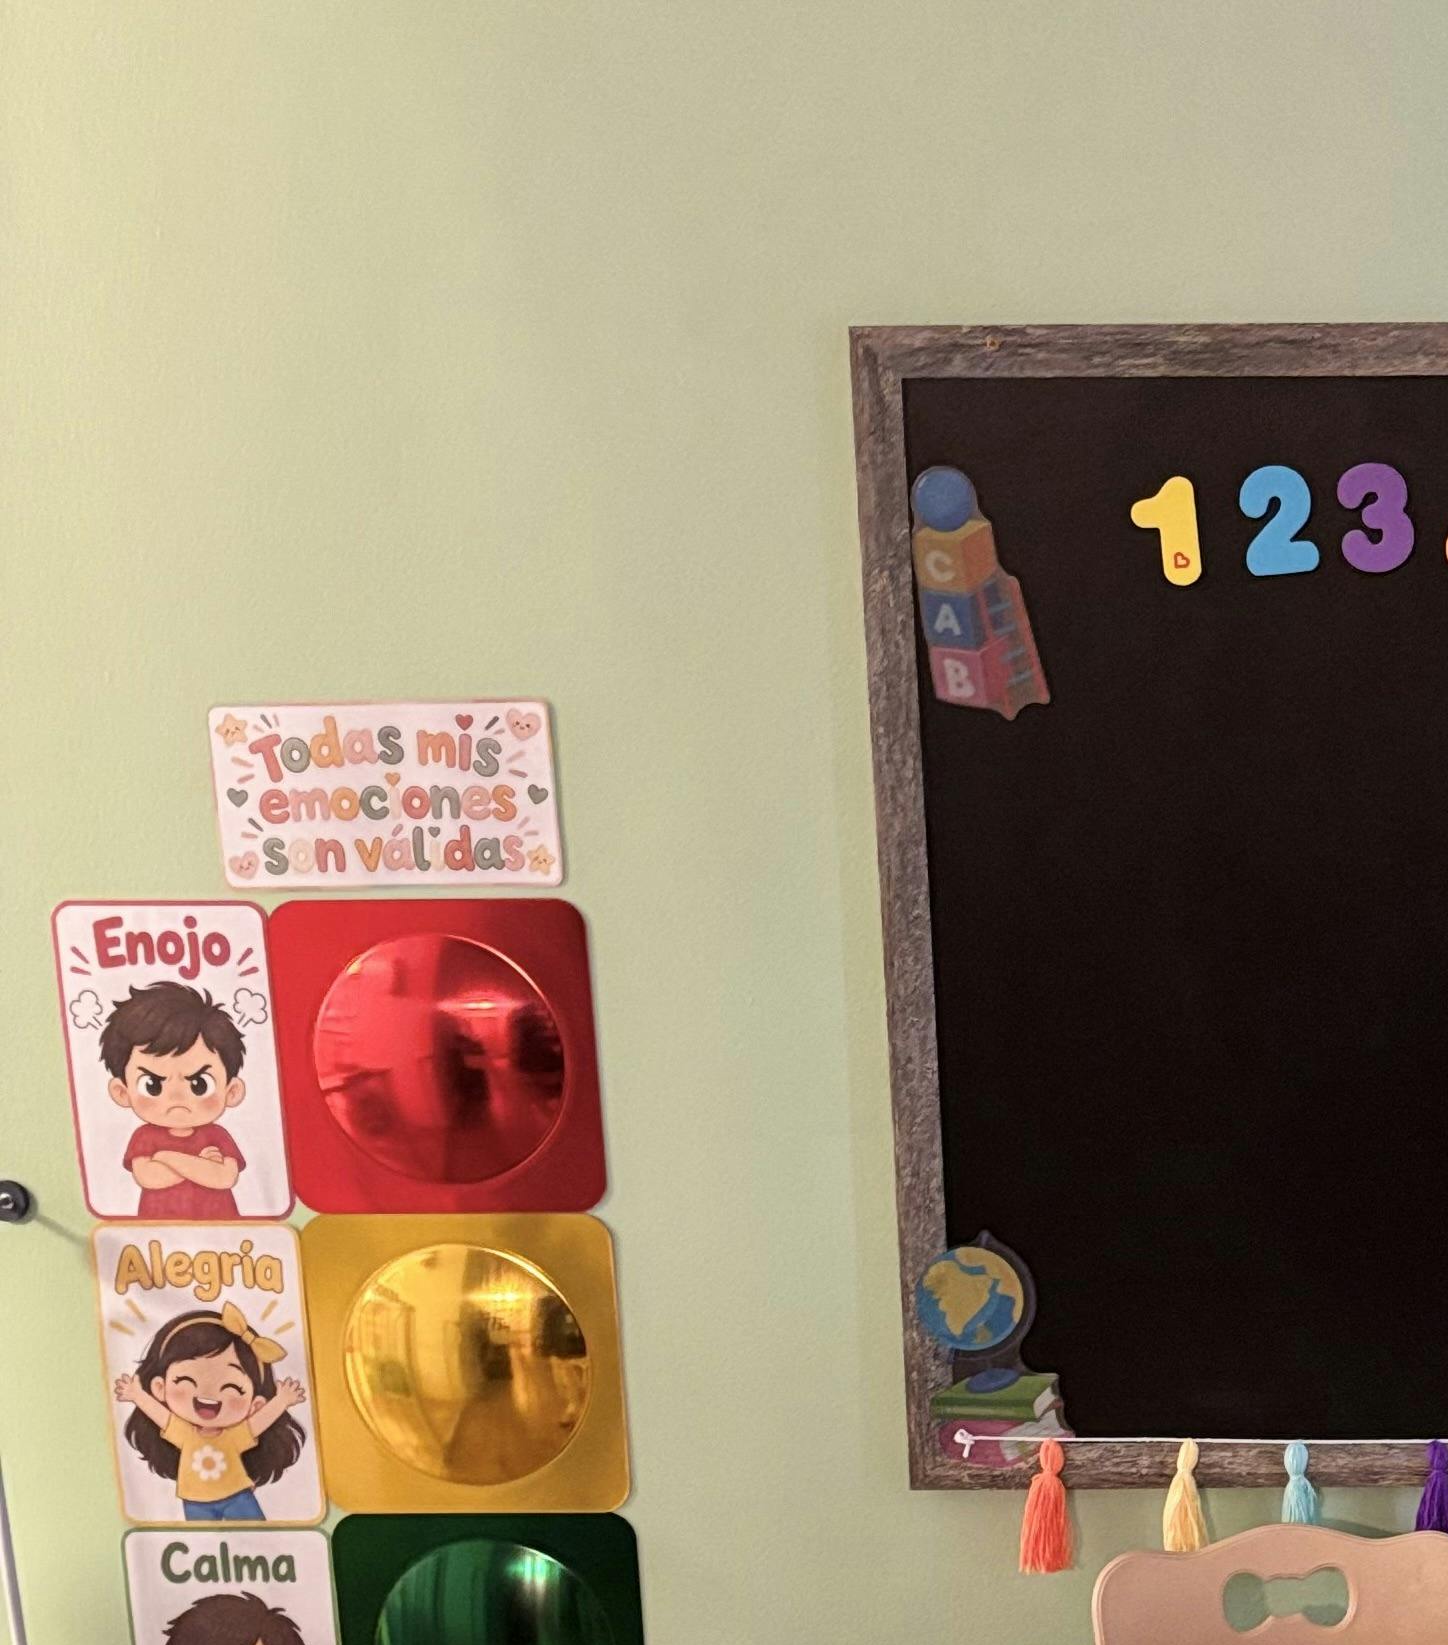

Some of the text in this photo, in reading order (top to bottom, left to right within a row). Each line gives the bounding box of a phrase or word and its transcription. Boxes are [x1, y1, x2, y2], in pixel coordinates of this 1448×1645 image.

[1131, 476, 1202, 586] 1
[1239, 465, 1320, 576] 2
[1337, 462, 1415, 573] 3
[924, 550, 956, 583] C
[933, 603, 961, 636] A
[943, 658, 976, 698] B
[248, 714, 502, 783] Todas mis
[259, 772, 518, 824] emociones
[262, 824, 525, 875] son válidas
[92, 915, 232, 980] Enojo
[160, 1541, 298, 1585] Calma
